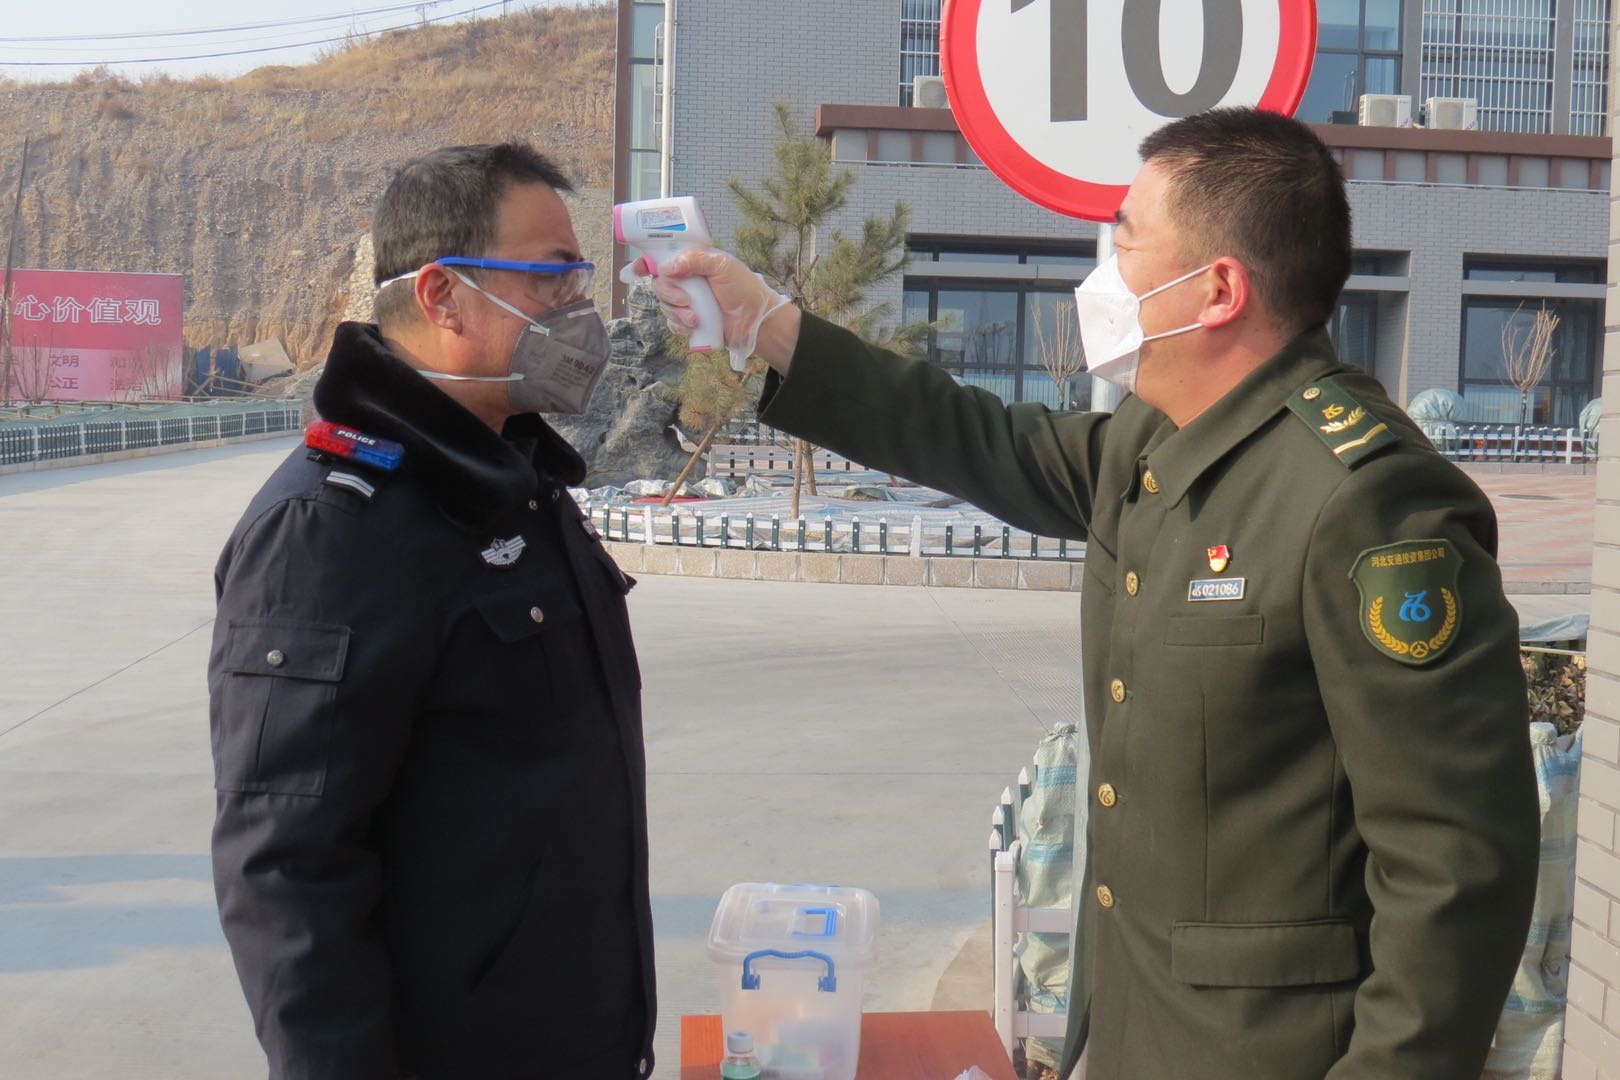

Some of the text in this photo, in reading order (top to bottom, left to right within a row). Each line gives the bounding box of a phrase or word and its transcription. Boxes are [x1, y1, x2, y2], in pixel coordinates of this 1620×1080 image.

[1010, 0, 1243, 122] 10
[337, 429, 376, 446] POLICE
[1202, 582, 1240, 597] 021086
